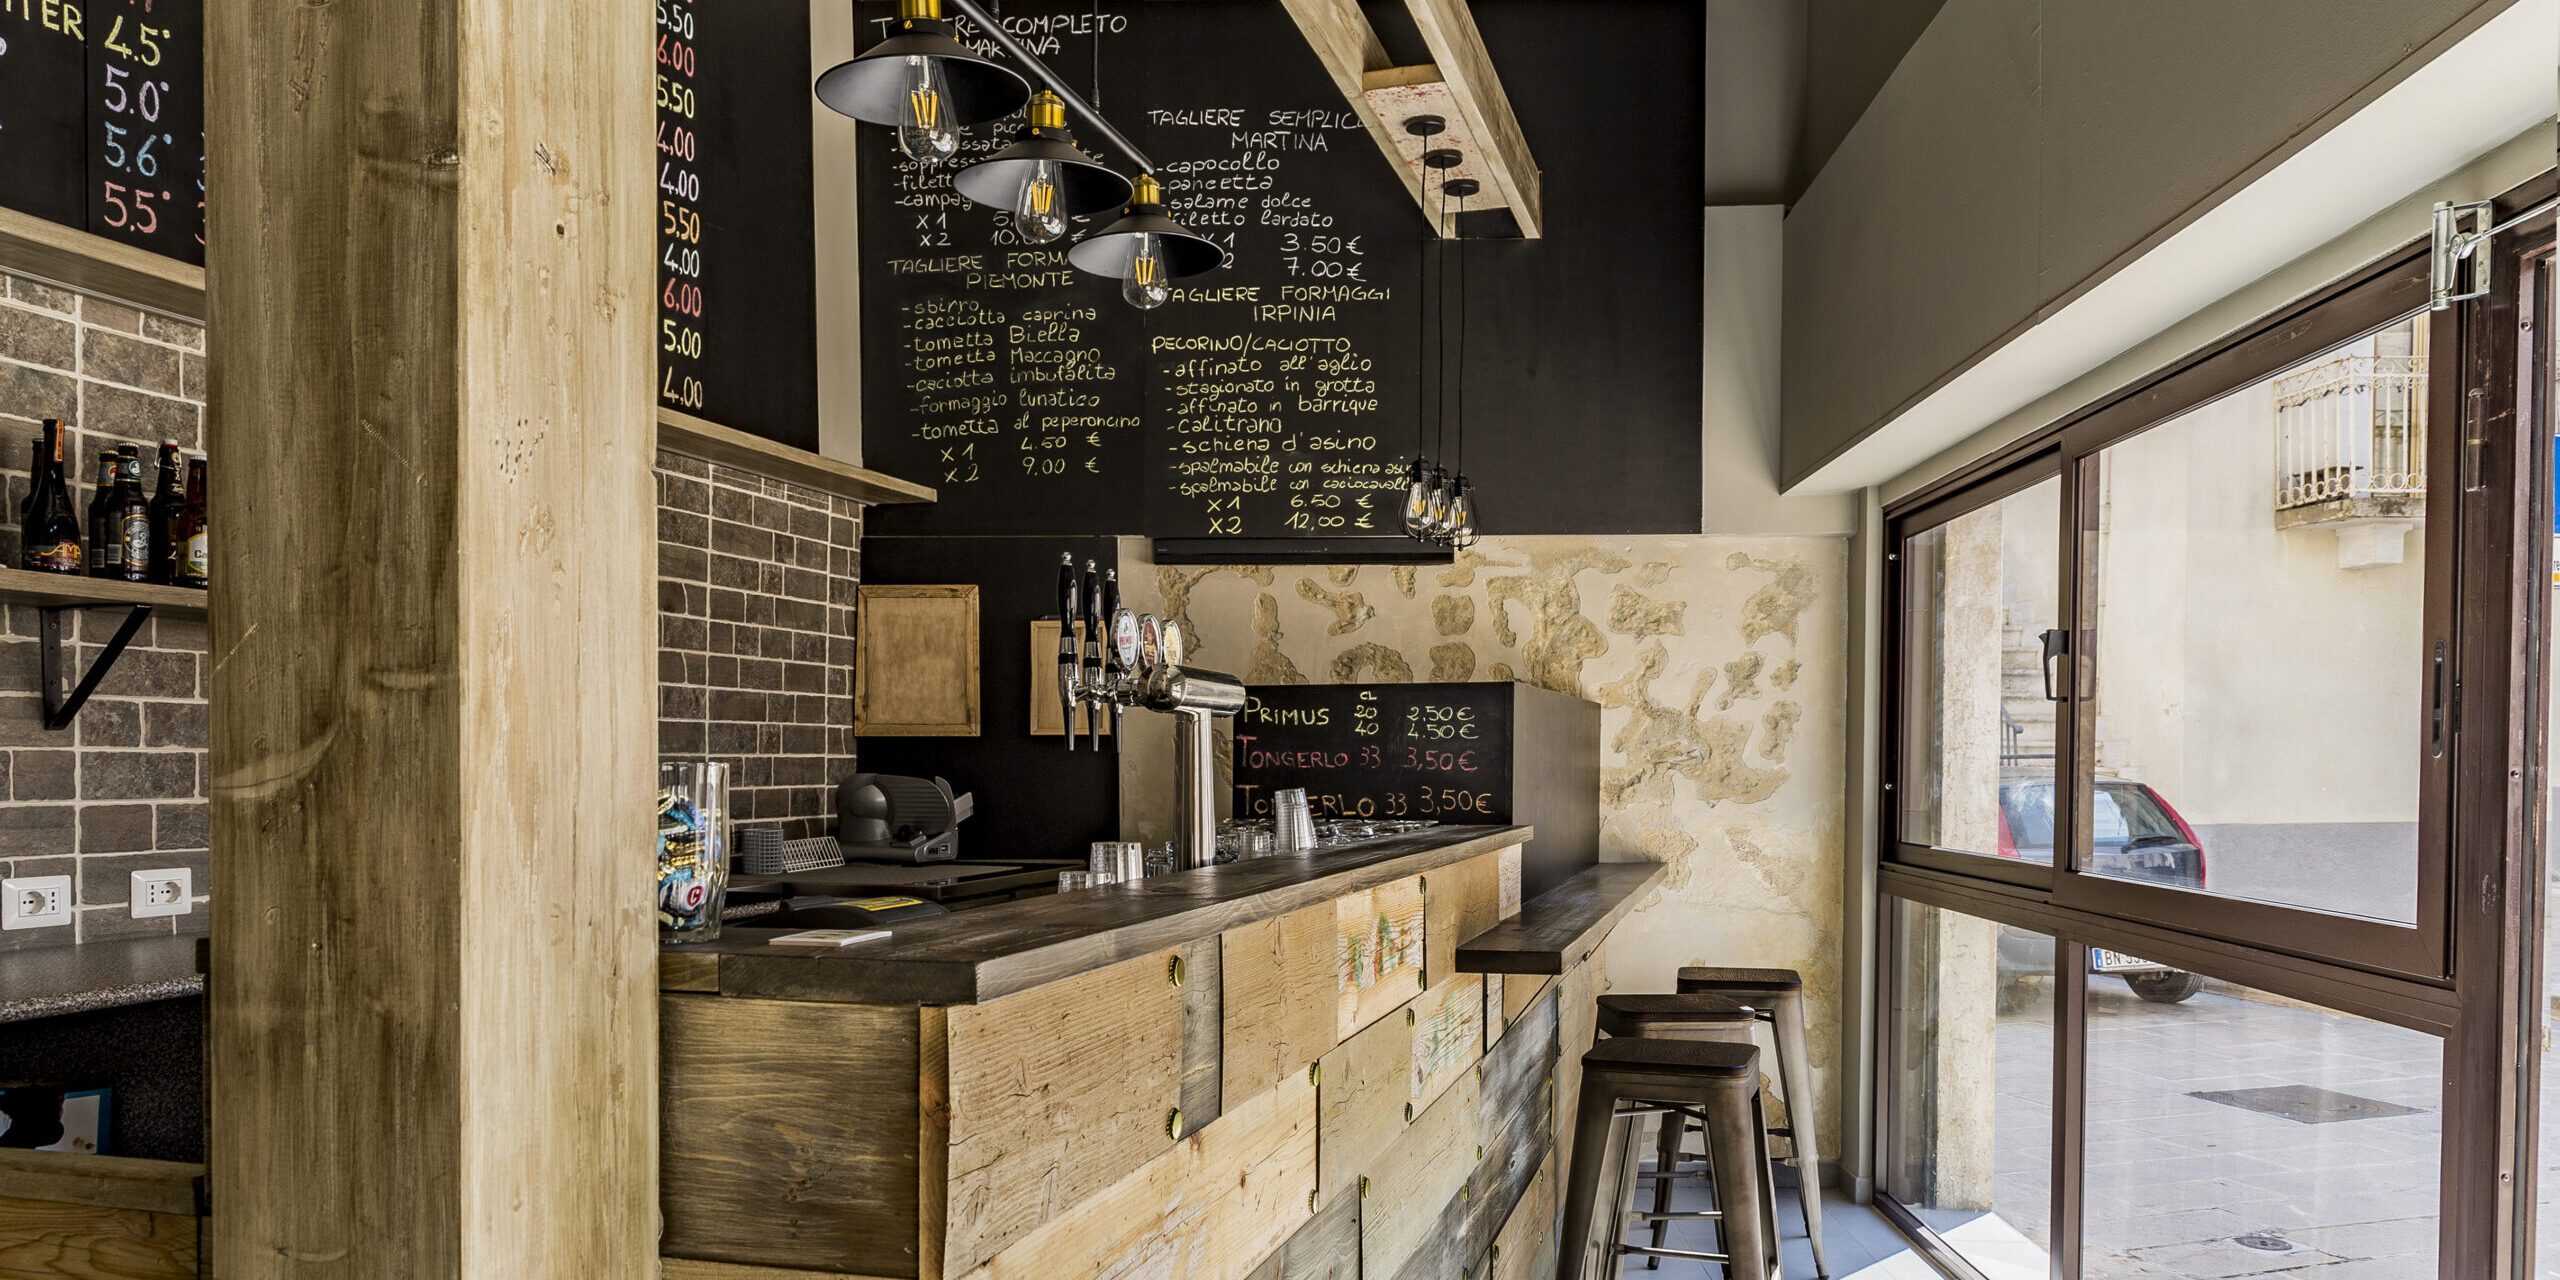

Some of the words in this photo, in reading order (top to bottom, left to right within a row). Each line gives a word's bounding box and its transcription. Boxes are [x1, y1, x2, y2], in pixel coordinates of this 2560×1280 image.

[1002, 15, 1127, 35] COMPLETO
[1147, 109, 1246, 126] TAGLIERE
[1231, 131, 1328, 152] MARTINA
[660, 161, 700, 202] 4,00
[1261, 192, 1312, 208] dolce
[663, 200, 700, 244] 5,50
[1260, 208, 1333, 227] lardato
[664, 242, 700, 278] 4,00
[887, 254, 984, 275] TAGLIERE
[1007, 250, 1068, 268] FORM
[966, 270, 1075, 290] PIEMONTE
[663, 277, 702, 318] 6,00
[1280, 284, 1391, 301] FORMAGGI
[1022, 302, 1097, 324] caprina
[1253, 304, 1337, 323] IRPINIA
[663, 318, 702, 359] 5,00
[1009, 322, 1081, 344] Biella
[1009, 346, 1101, 370] Maccagno
[1009, 365, 1117, 384] imbufalita
[663, 366, 704, 410] 4,00
[1284, 375, 1300, 392] in
[1314, 376, 1376, 398] grotta
[1018, 387, 1101, 408] lunatico
[1269, 399, 1282, 412] in
[1297, 394, 1379, 416] barrique
[1013, 411, 1030, 430] al
[1041, 413, 1142, 431] peperoncino
[1085, 431, 1102, 447] €
[1084, 456, 1101, 474] €
[1288, 462, 1313, 474] con
[1320, 458, 1380, 474] schiena
[1289, 477, 1310, 490] con
[1322, 474, 1410, 491] caciocavall
[1290, 494, 1342, 509] 6.50
[1355, 493, 1375, 509] €
[1354, 512, 1375, 529] €
[1353, 704, 1378, 719] 20
[1354, 719, 1380, 737] 40
[1236, 783, 1375, 818] TOERLO
